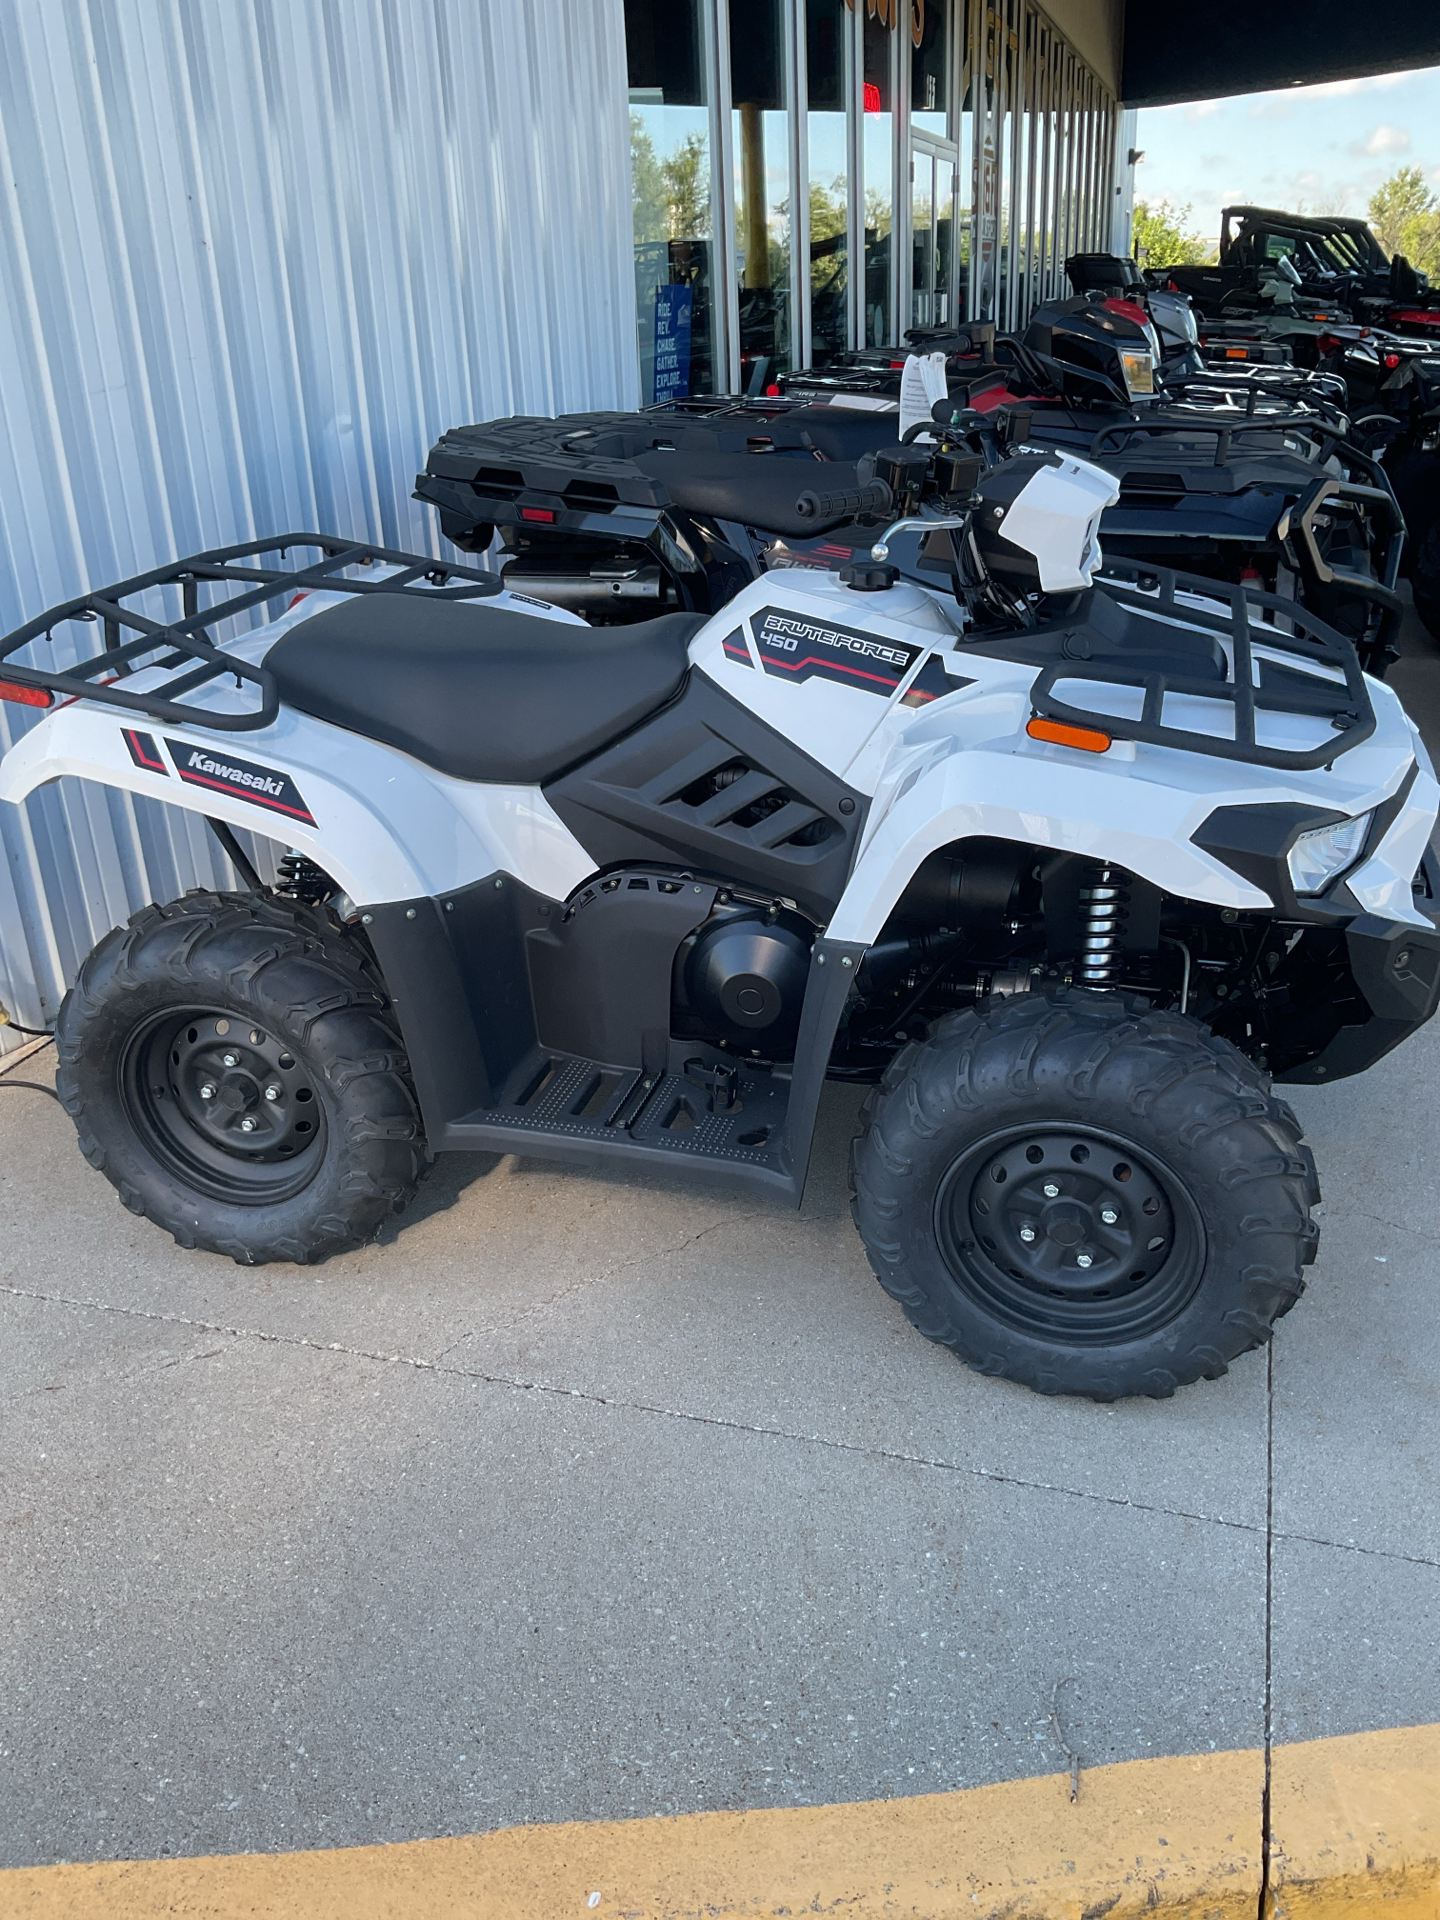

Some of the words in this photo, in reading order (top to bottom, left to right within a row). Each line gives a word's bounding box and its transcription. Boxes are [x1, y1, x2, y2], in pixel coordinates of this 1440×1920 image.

[656, 354, 679, 371] GATHER.
[656, 371, 681, 389] EXPLORE.
[760, 631, 798, 652] 450
[188, 751, 285, 796] Kawasaki
